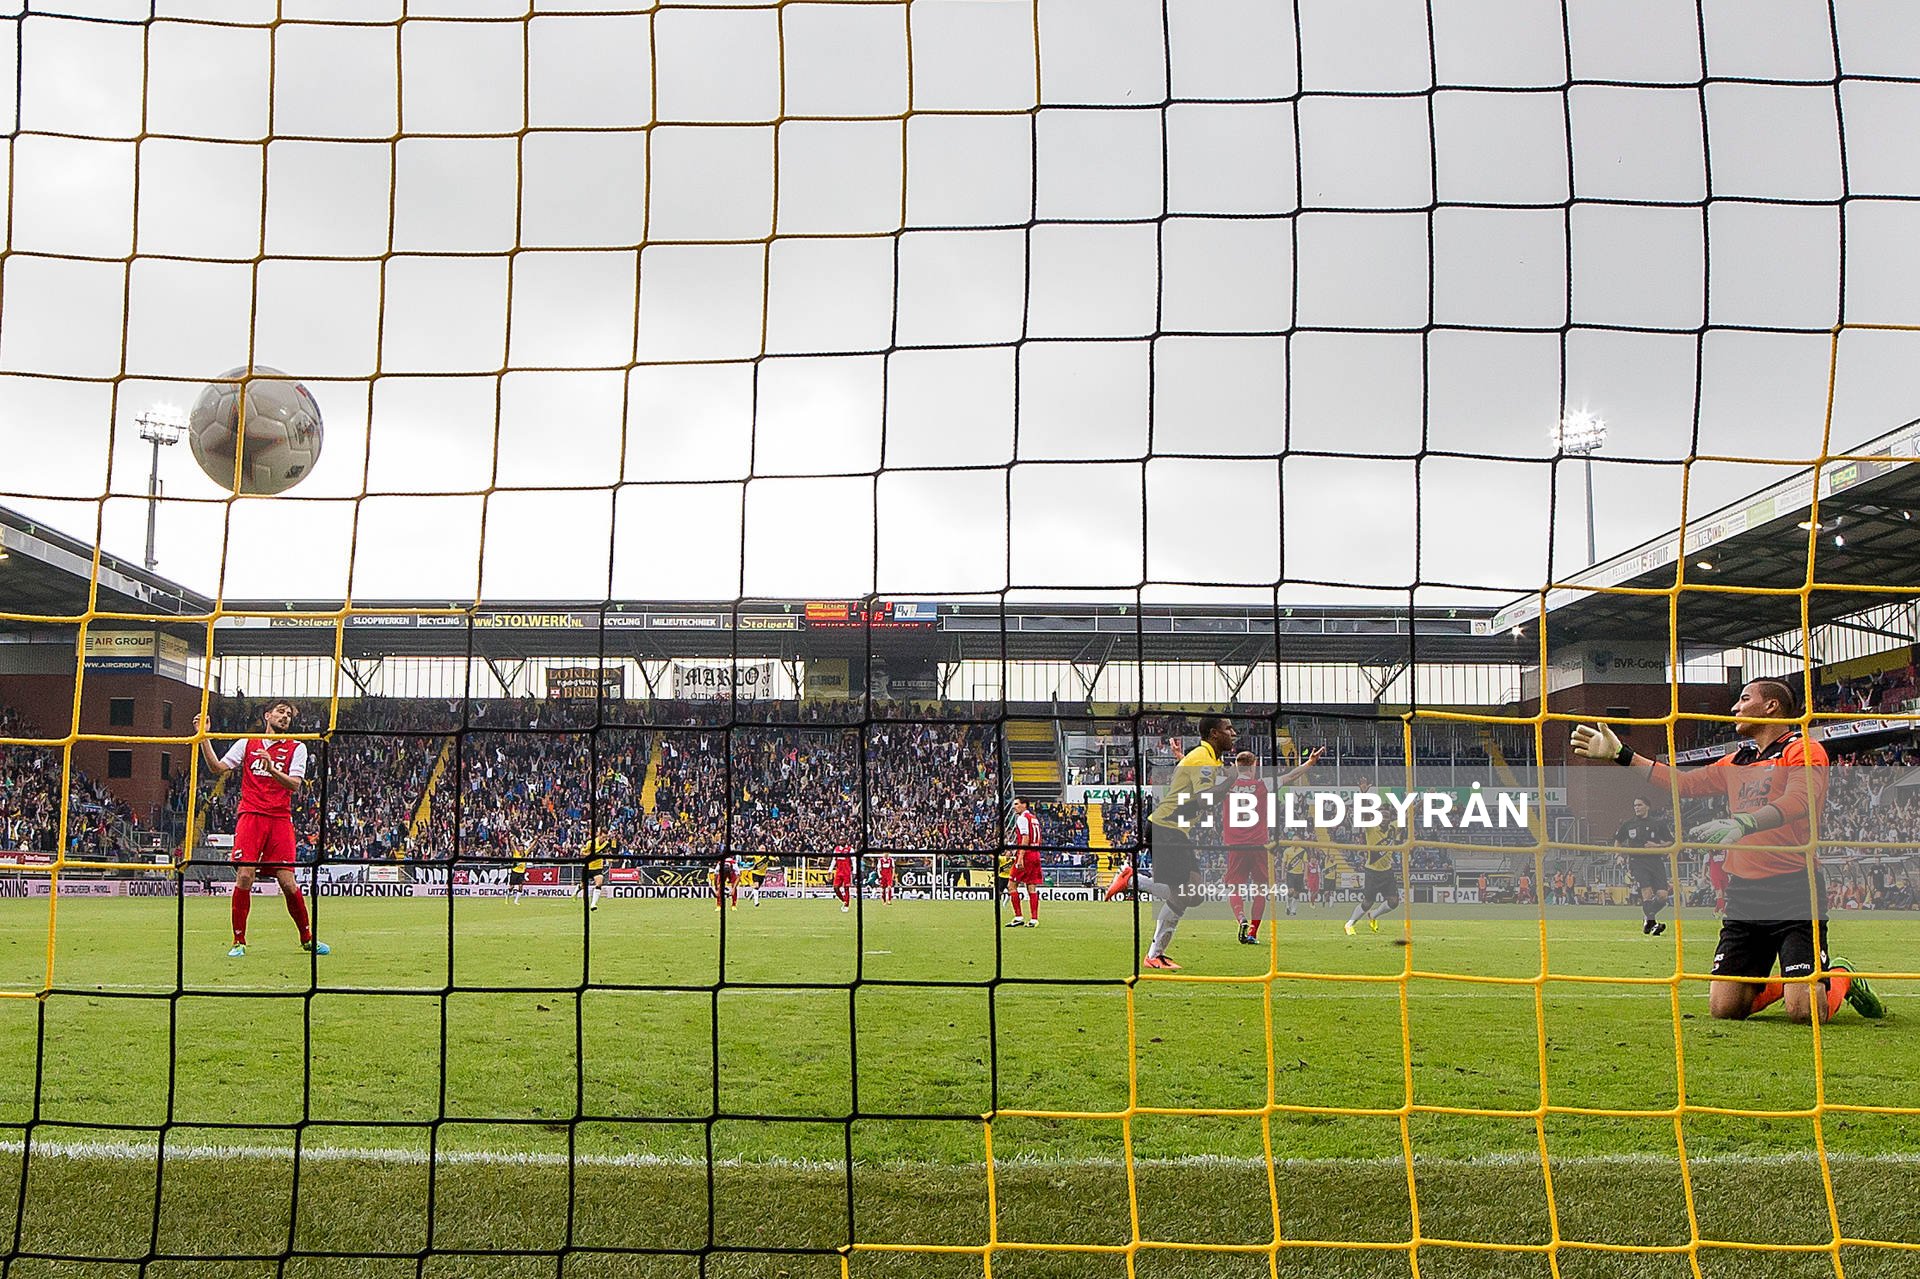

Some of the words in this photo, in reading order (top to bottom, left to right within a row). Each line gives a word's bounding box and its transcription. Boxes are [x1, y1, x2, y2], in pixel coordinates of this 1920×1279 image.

[353, 616, 409, 625] SLOOPWERKEN
[419, 616, 460, 625] RECYCLING
[652, 618, 717, 626] MILIEUTECHNIEK
[740, 617, 795, 629] Stolwerk
[94, 637, 113, 646] AIR
[115, 637, 154, 646] GROUP
[1614, 657, 1665, 671] BVR-Groep
[684, 667, 760, 687] MARCO
[537, 888, 572, 896] PAYROLL
[936, 887, 990, 900] telecom
